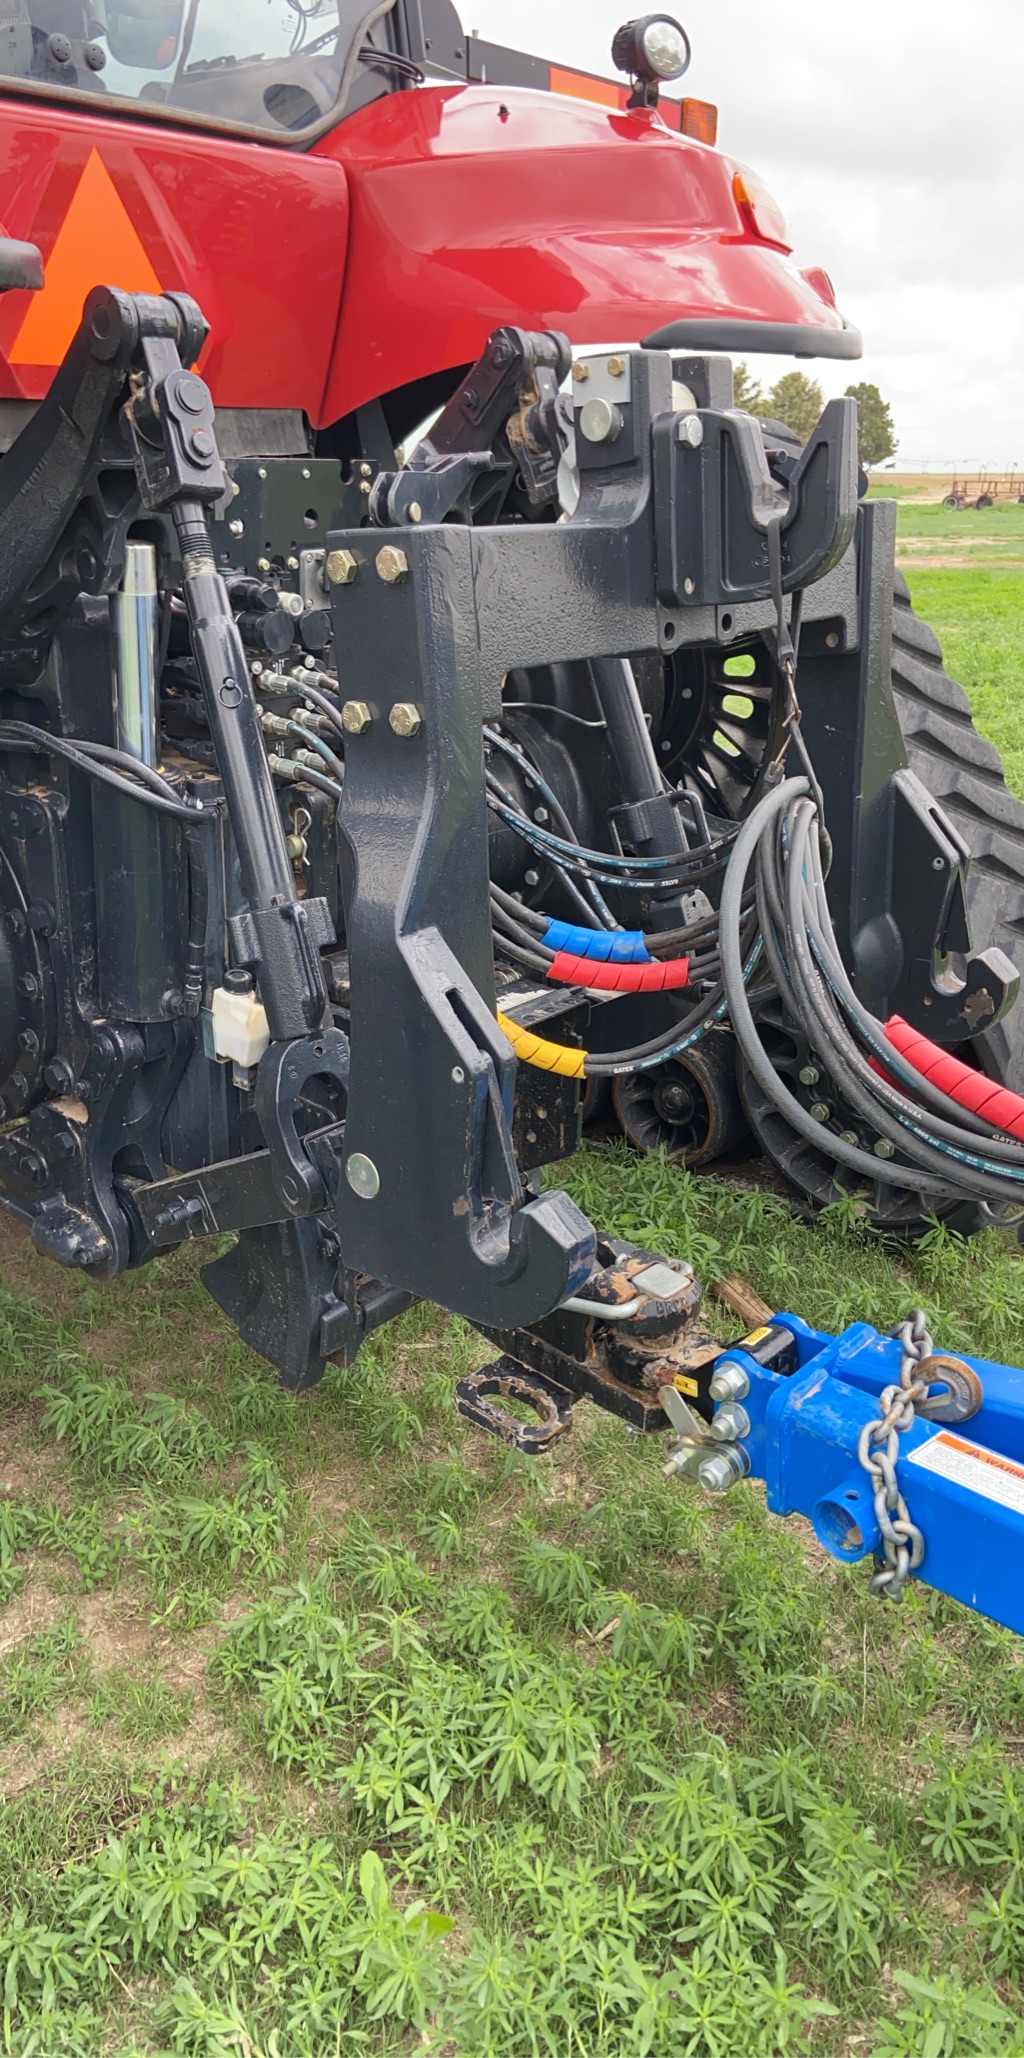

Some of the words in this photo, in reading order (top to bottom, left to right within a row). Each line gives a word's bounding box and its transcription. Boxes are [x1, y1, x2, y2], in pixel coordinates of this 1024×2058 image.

[612, 1065, 634, 1074] GATES
[856, 1062, 878, 1085] Engineered
[912, 1127, 929, 1140] 4800
[928, 1137, 940, 1147] psi
